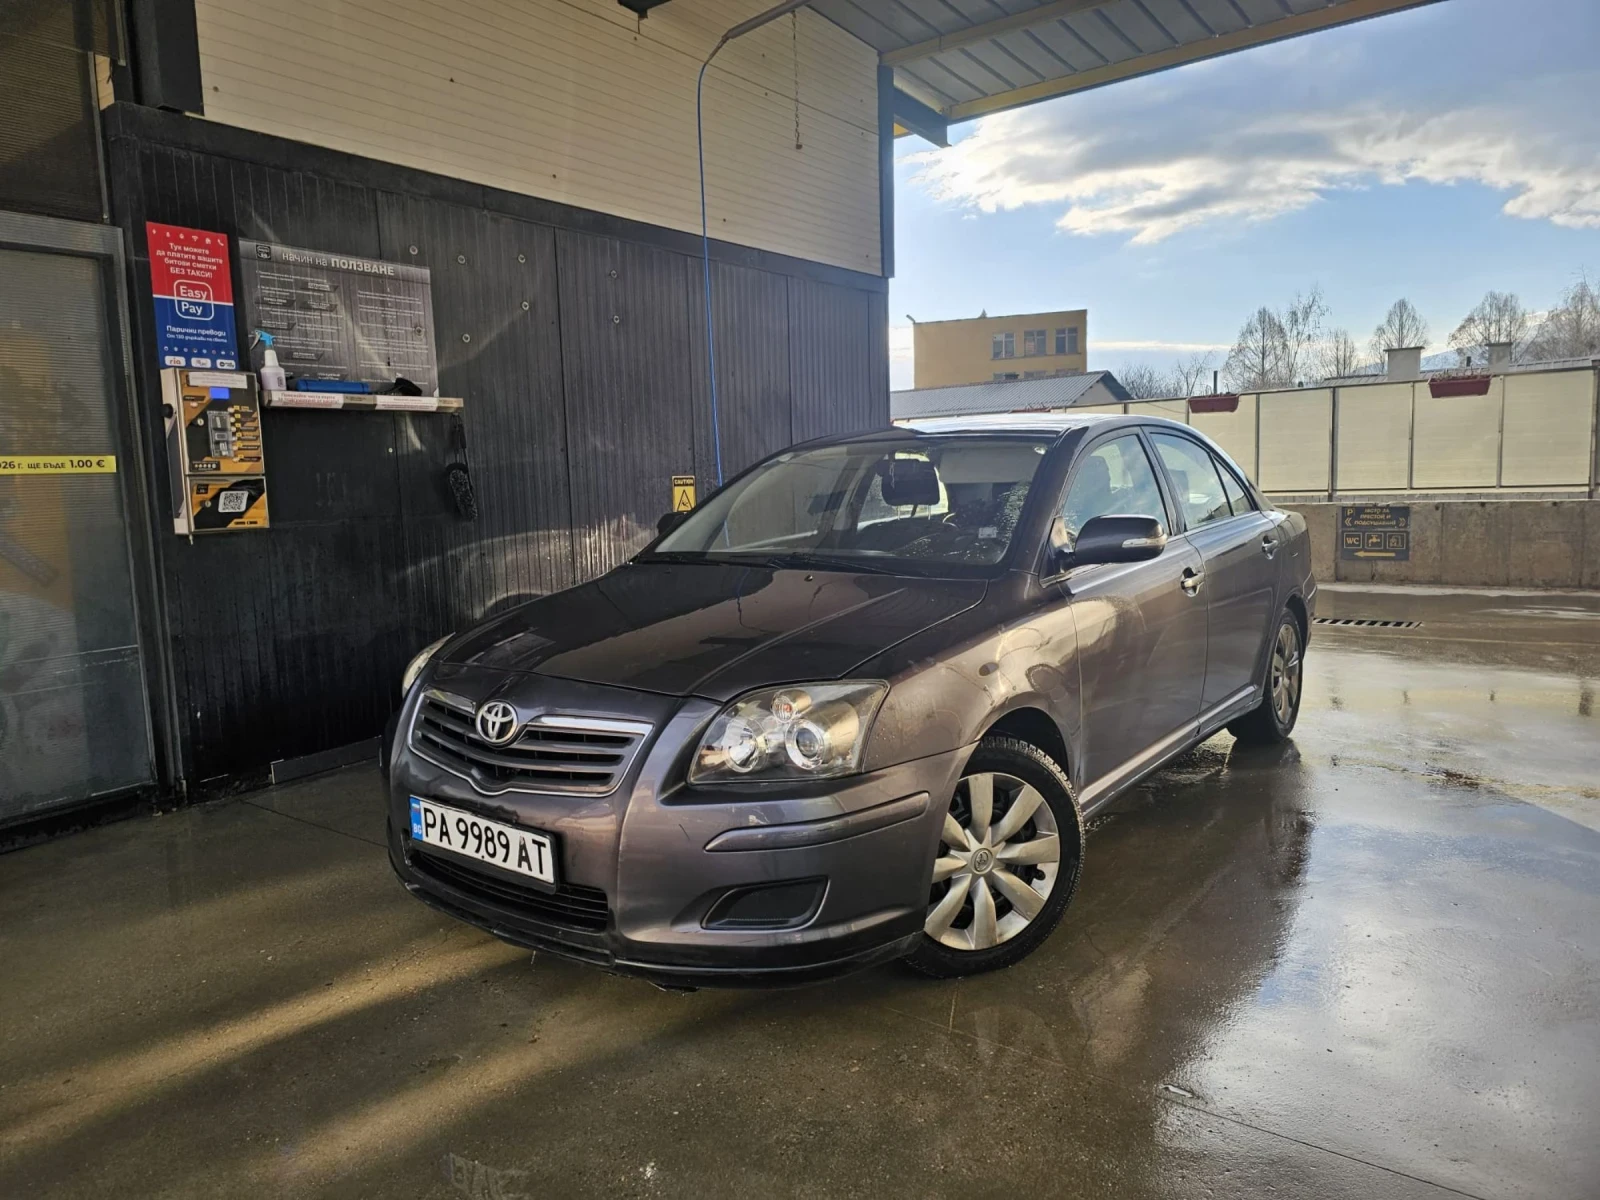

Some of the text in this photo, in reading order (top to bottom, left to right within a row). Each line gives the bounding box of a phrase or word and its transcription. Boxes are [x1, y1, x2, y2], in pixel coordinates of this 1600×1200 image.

[169, 242, 209, 255] Тук можете
[156, 249, 223, 264] да платите вашите
[164, 257, 217, 270] битови сметки
[282, 252, 313, 264] начин
[315, 257, 328, 266] на
[331, 258, 395, 276] ПОЛЗВАНЕ
[170, 266, 213, 279] БЕЗ ТАКСИ!
[179, 285, 208, 300] Easy
[181, 301, 202, 315] Pay
[166, 325, 226, 337] Парични преводи
[169, 357, 181, 365] ria
[0, 460, 16, 469] 26
[27, 462, 41, 470] ЩЕ
[69, 459, 93, 468] 1.00
[95, 459, 105, 468] €
[413, 823, 422, 833] BG
[423, 807, 547, 875] PA 9989 AT
